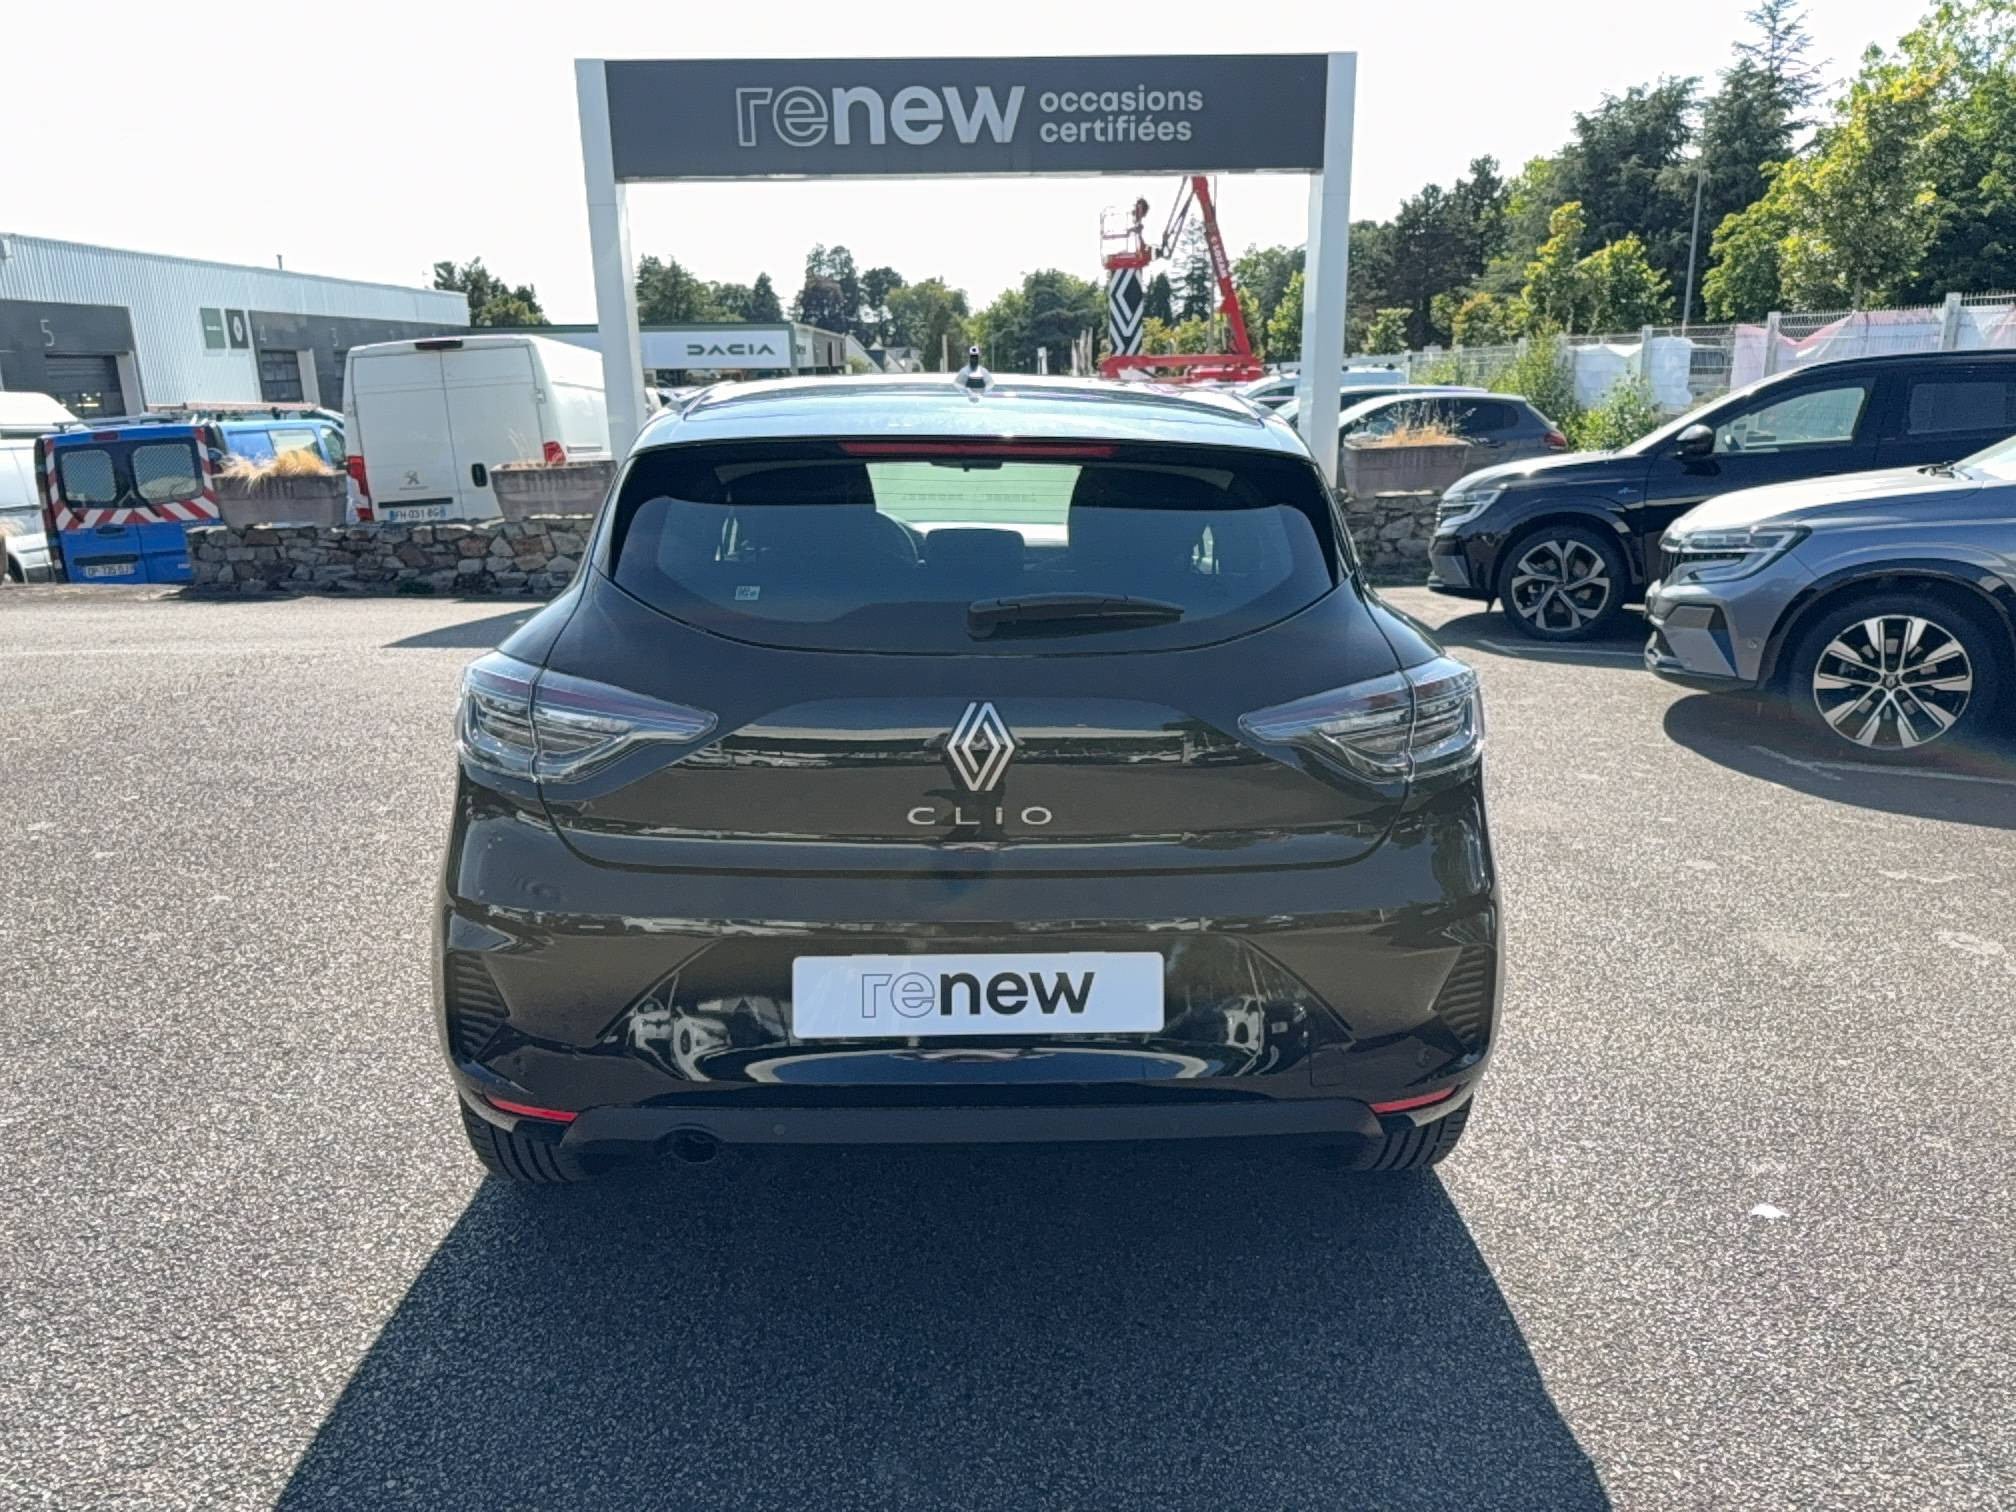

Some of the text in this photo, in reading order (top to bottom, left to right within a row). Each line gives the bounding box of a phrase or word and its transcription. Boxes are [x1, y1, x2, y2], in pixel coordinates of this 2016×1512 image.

[1039, 84, 1204, 113] occasions
[735, 85, 1025, 147] renew
[1039, 114, 1193, 144] certifiées
[39, 319, 55, 347] 5
[686, 343, 775, 356] DACIA
[906, 805, 1053, 826] CLIO
[861, 971, 1095, 1018] renew
